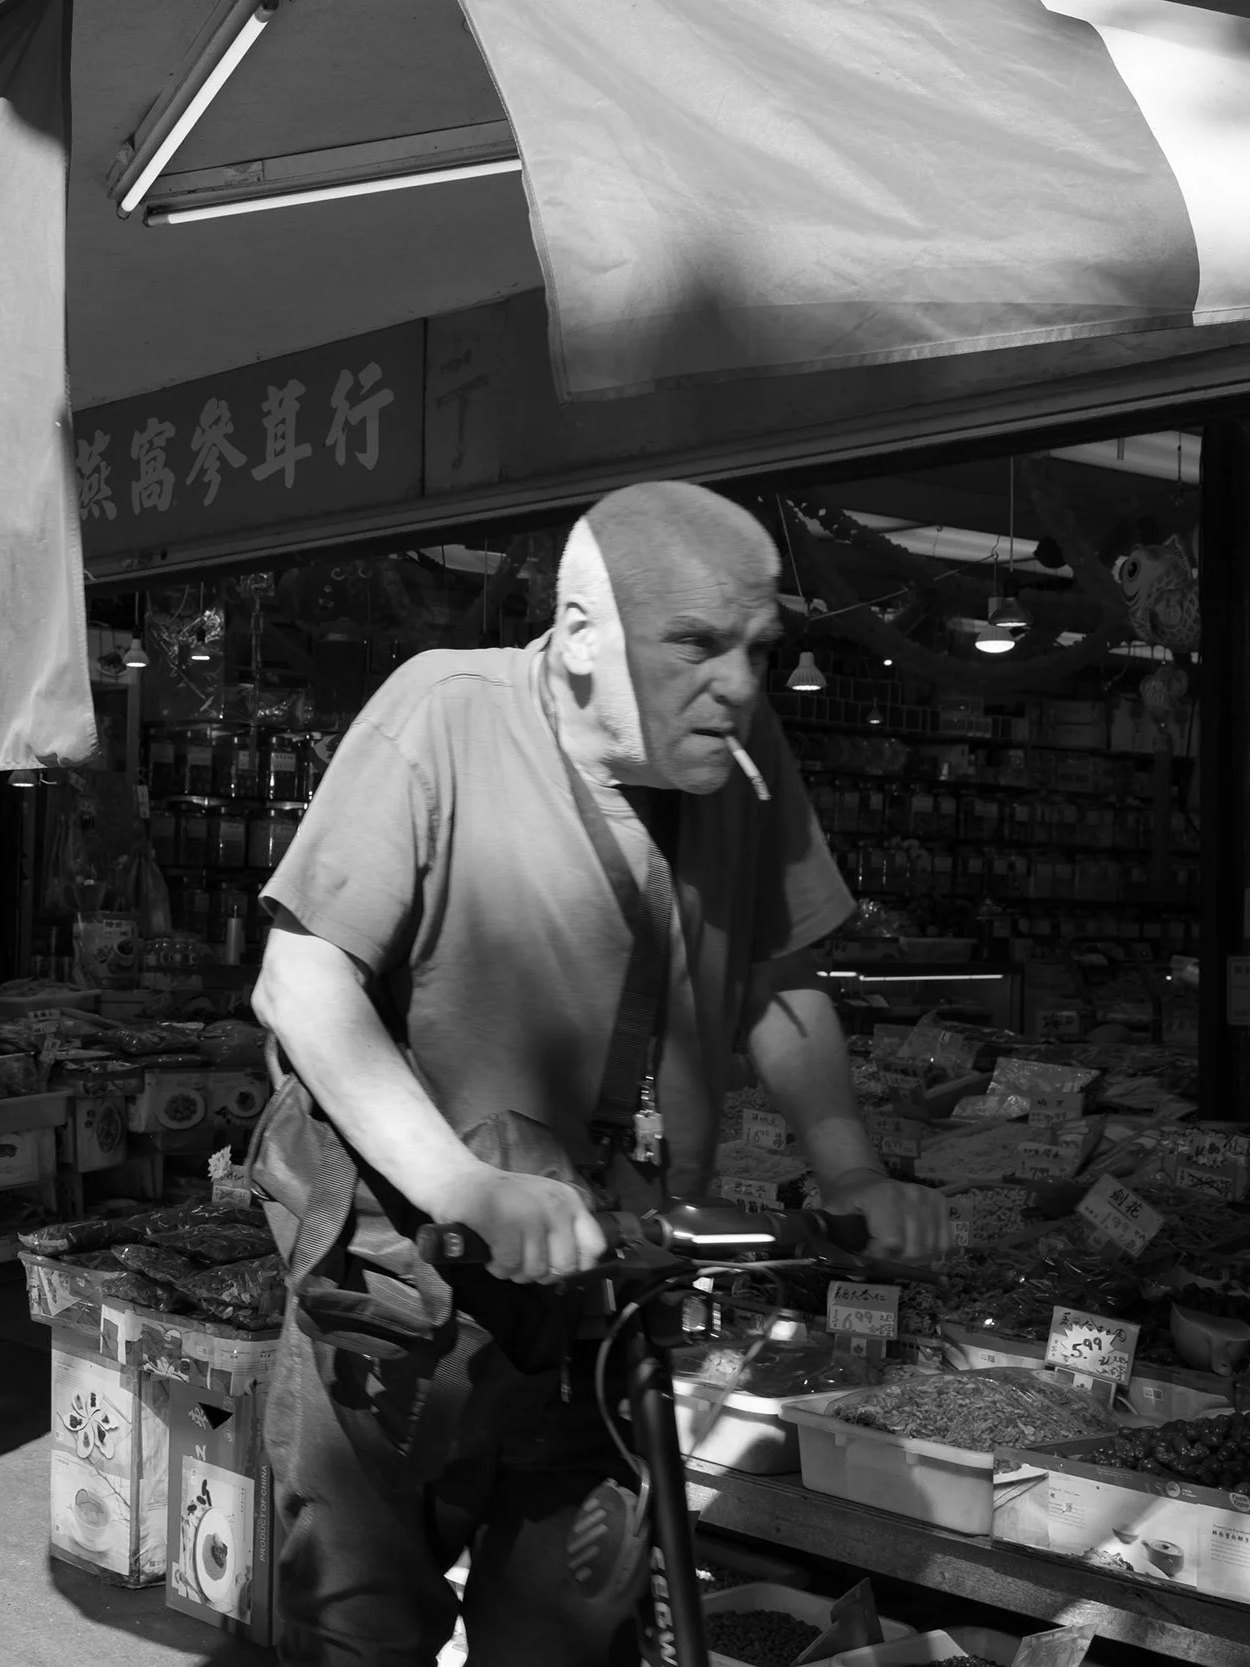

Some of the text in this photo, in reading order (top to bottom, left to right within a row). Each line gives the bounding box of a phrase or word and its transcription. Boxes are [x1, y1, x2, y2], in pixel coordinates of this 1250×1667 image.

[1069, 1336, 1103, 1360] 5.99
[259, 1465, 268, 1562] PRODUCT OF CHINA
